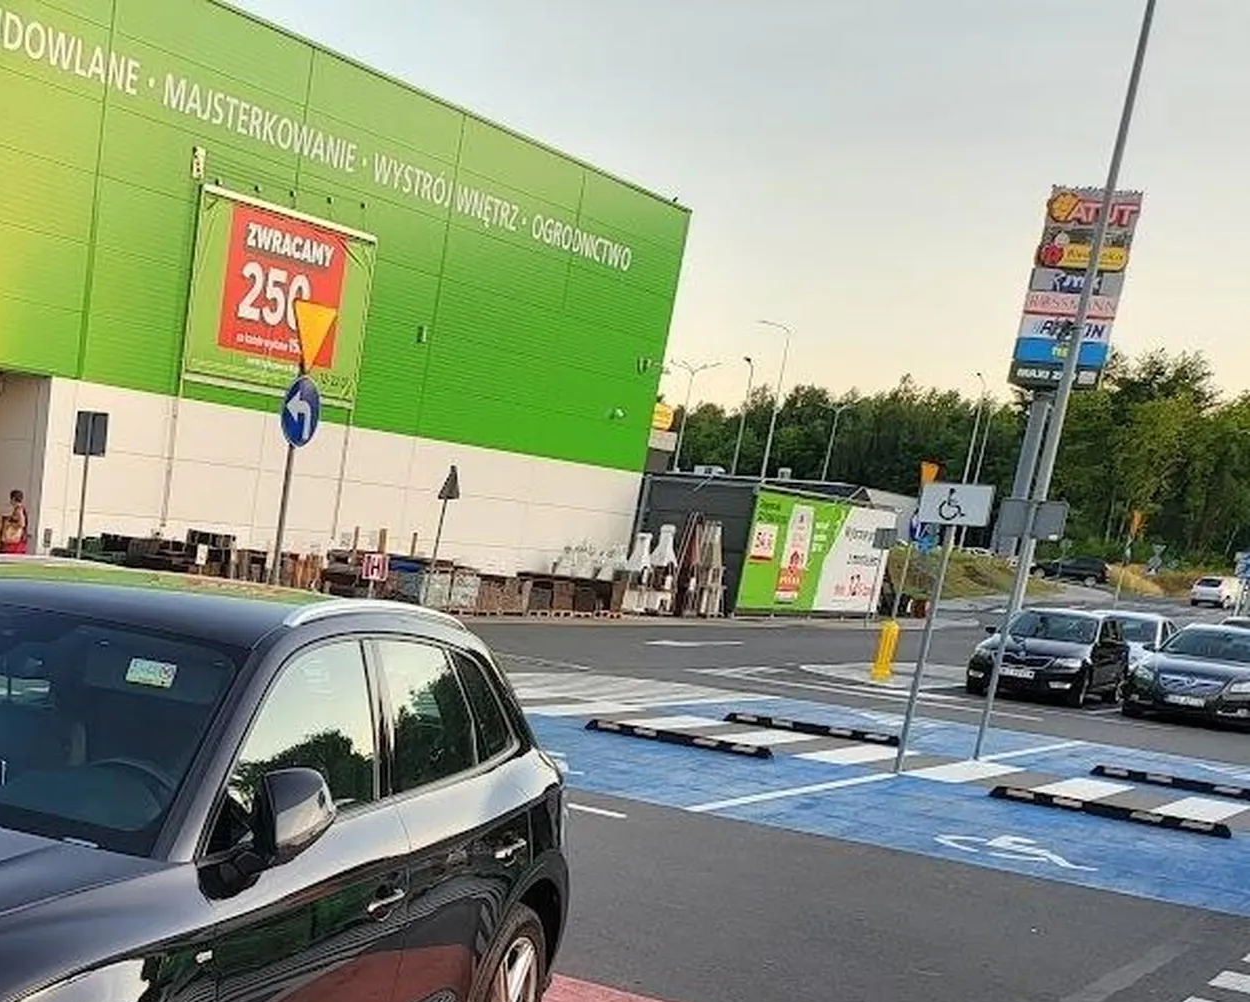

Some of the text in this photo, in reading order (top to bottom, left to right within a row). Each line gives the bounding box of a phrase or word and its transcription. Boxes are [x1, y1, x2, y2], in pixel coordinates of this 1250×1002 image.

[162, 73, 358, 173] MAJSTERKOWANIE
[373, 153, 454, 208] WYSTRÓJ
[456, 184, 520, 232] WNĘTRZ
[532, 214, 632, 272] OGRODNICTWO
[246, 221, 335, 267] ZWRACAMY
